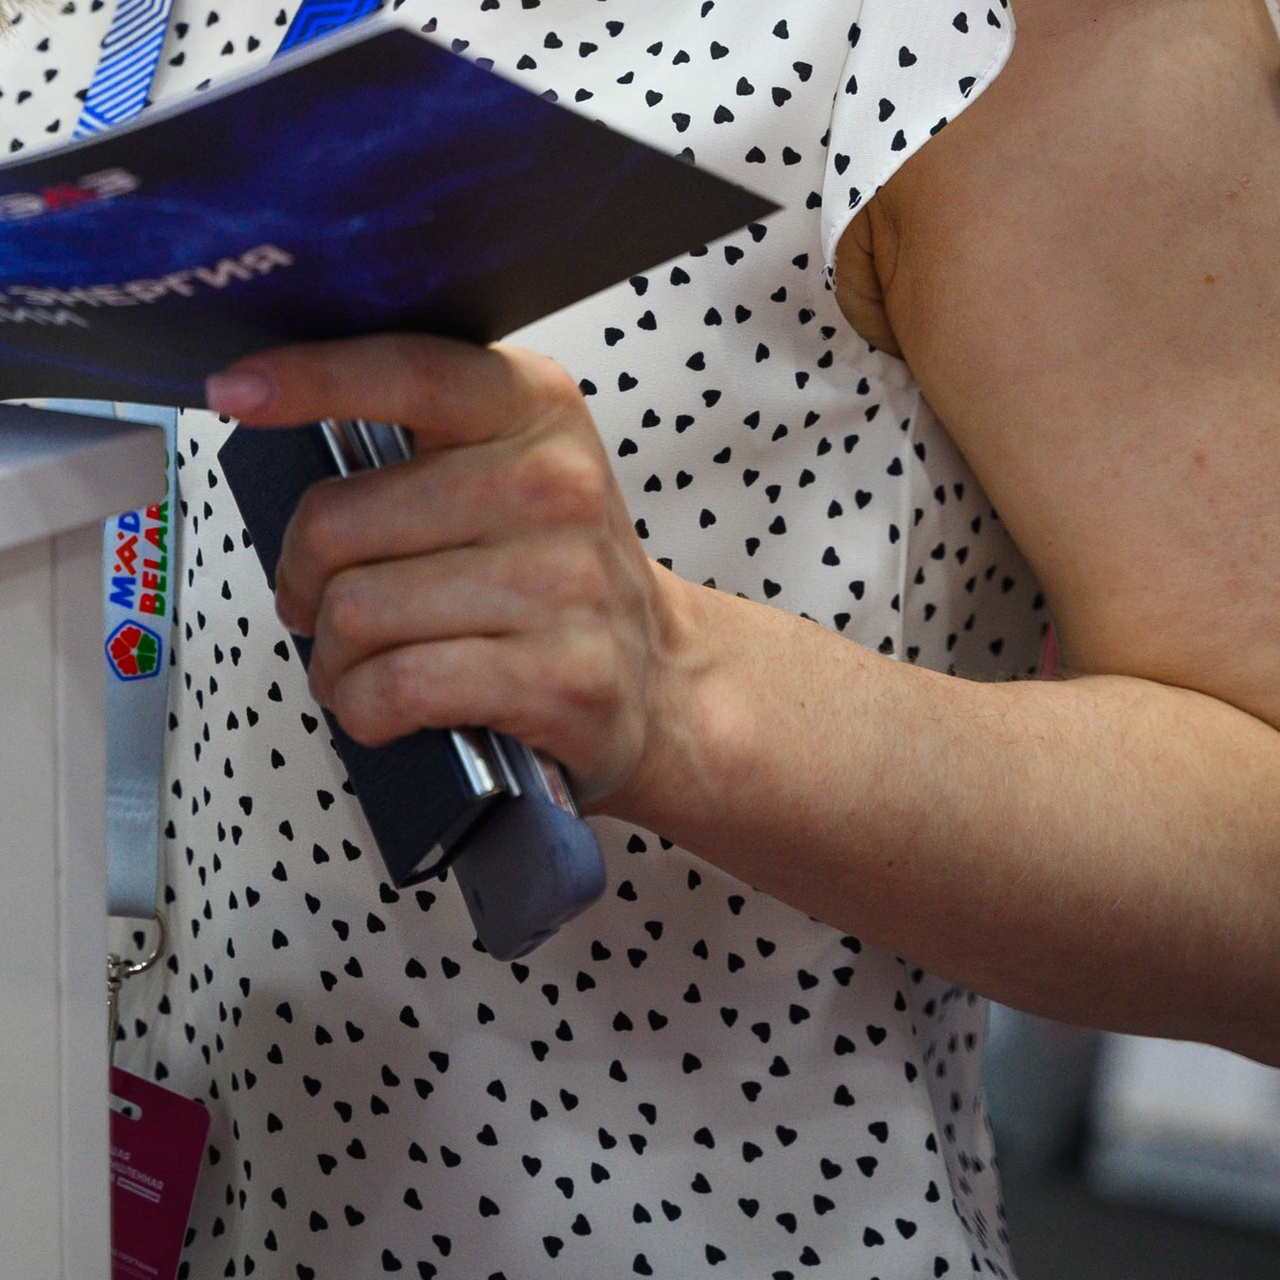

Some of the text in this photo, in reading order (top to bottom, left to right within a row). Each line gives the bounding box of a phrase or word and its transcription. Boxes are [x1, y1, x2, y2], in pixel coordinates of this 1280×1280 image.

[8, 243, 296, 308] ЭНЕРГИЯ
[109, 510, 140, 610] MAD
[139, 500, 169, 617] BELAR
